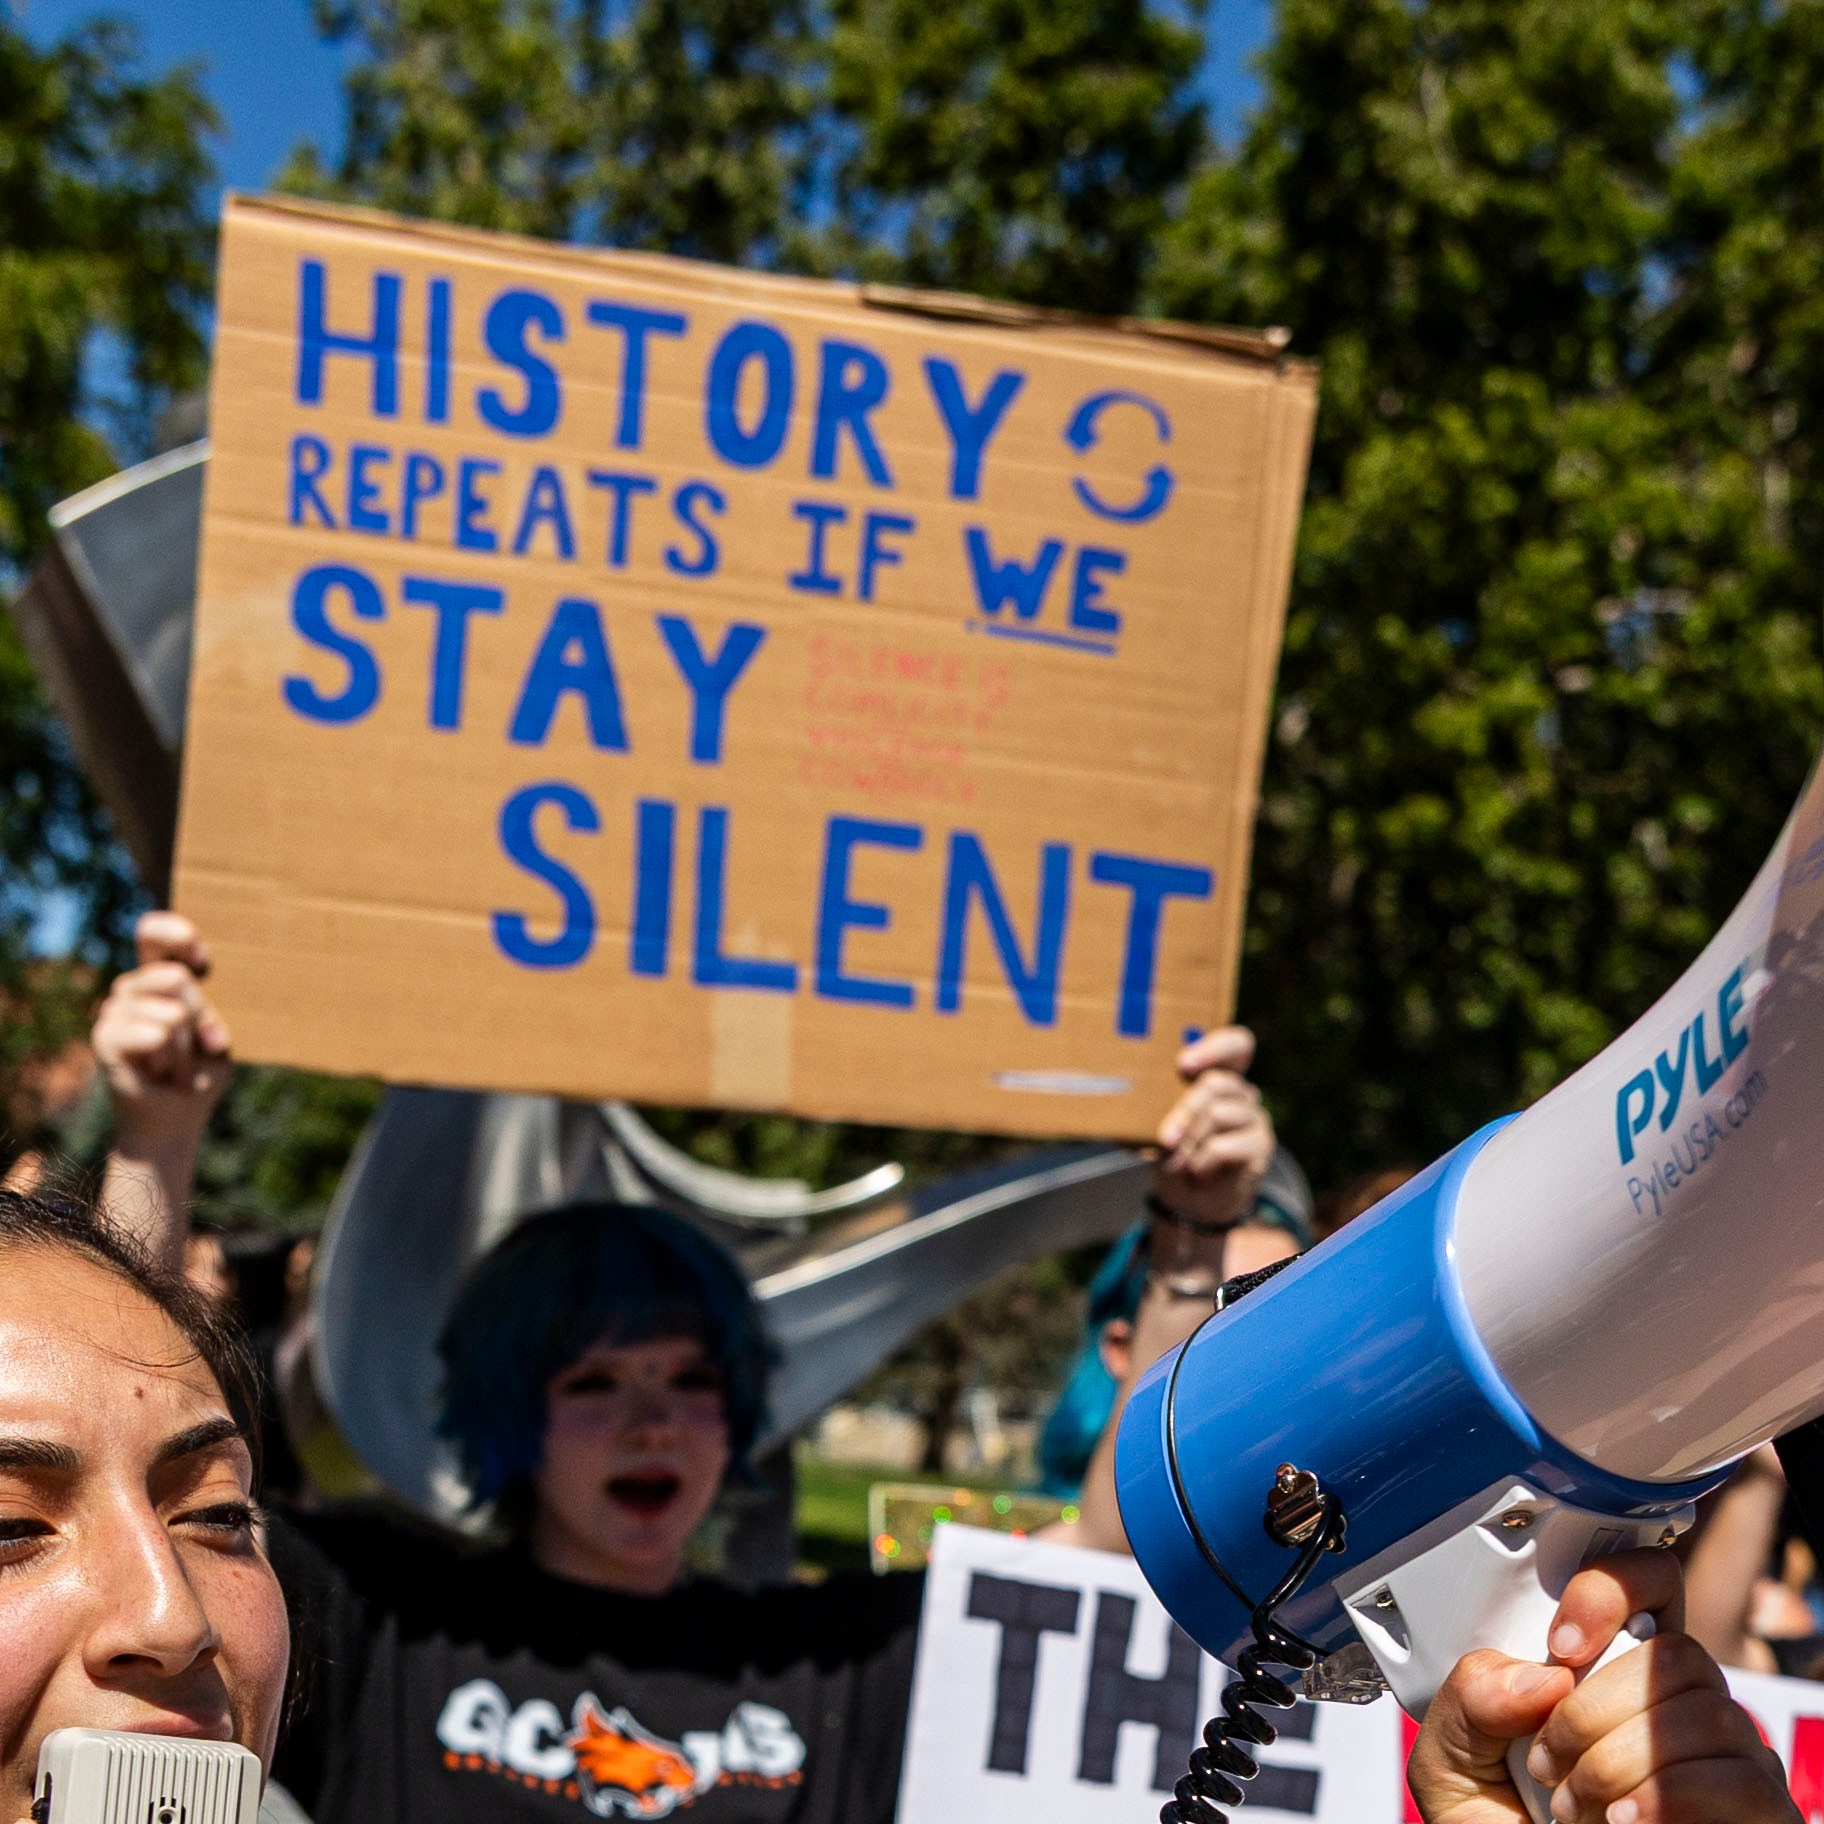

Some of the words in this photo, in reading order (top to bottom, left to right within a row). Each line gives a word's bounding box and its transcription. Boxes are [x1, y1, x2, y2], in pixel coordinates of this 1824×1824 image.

[297, 257, 1027, 501] HISTORY
[287, 432, 727, 580] REPEATS
[788, 498, 918, 601] IF
[964, 525, 1128, 634] WE
[281, 562, 768, 766] STAY
[1616, 955, 1752, 1166] PYLE
[1627, 1069, 1770, 1217] PyleUSA.com
[965, 1570, 1319, 1816] THE
